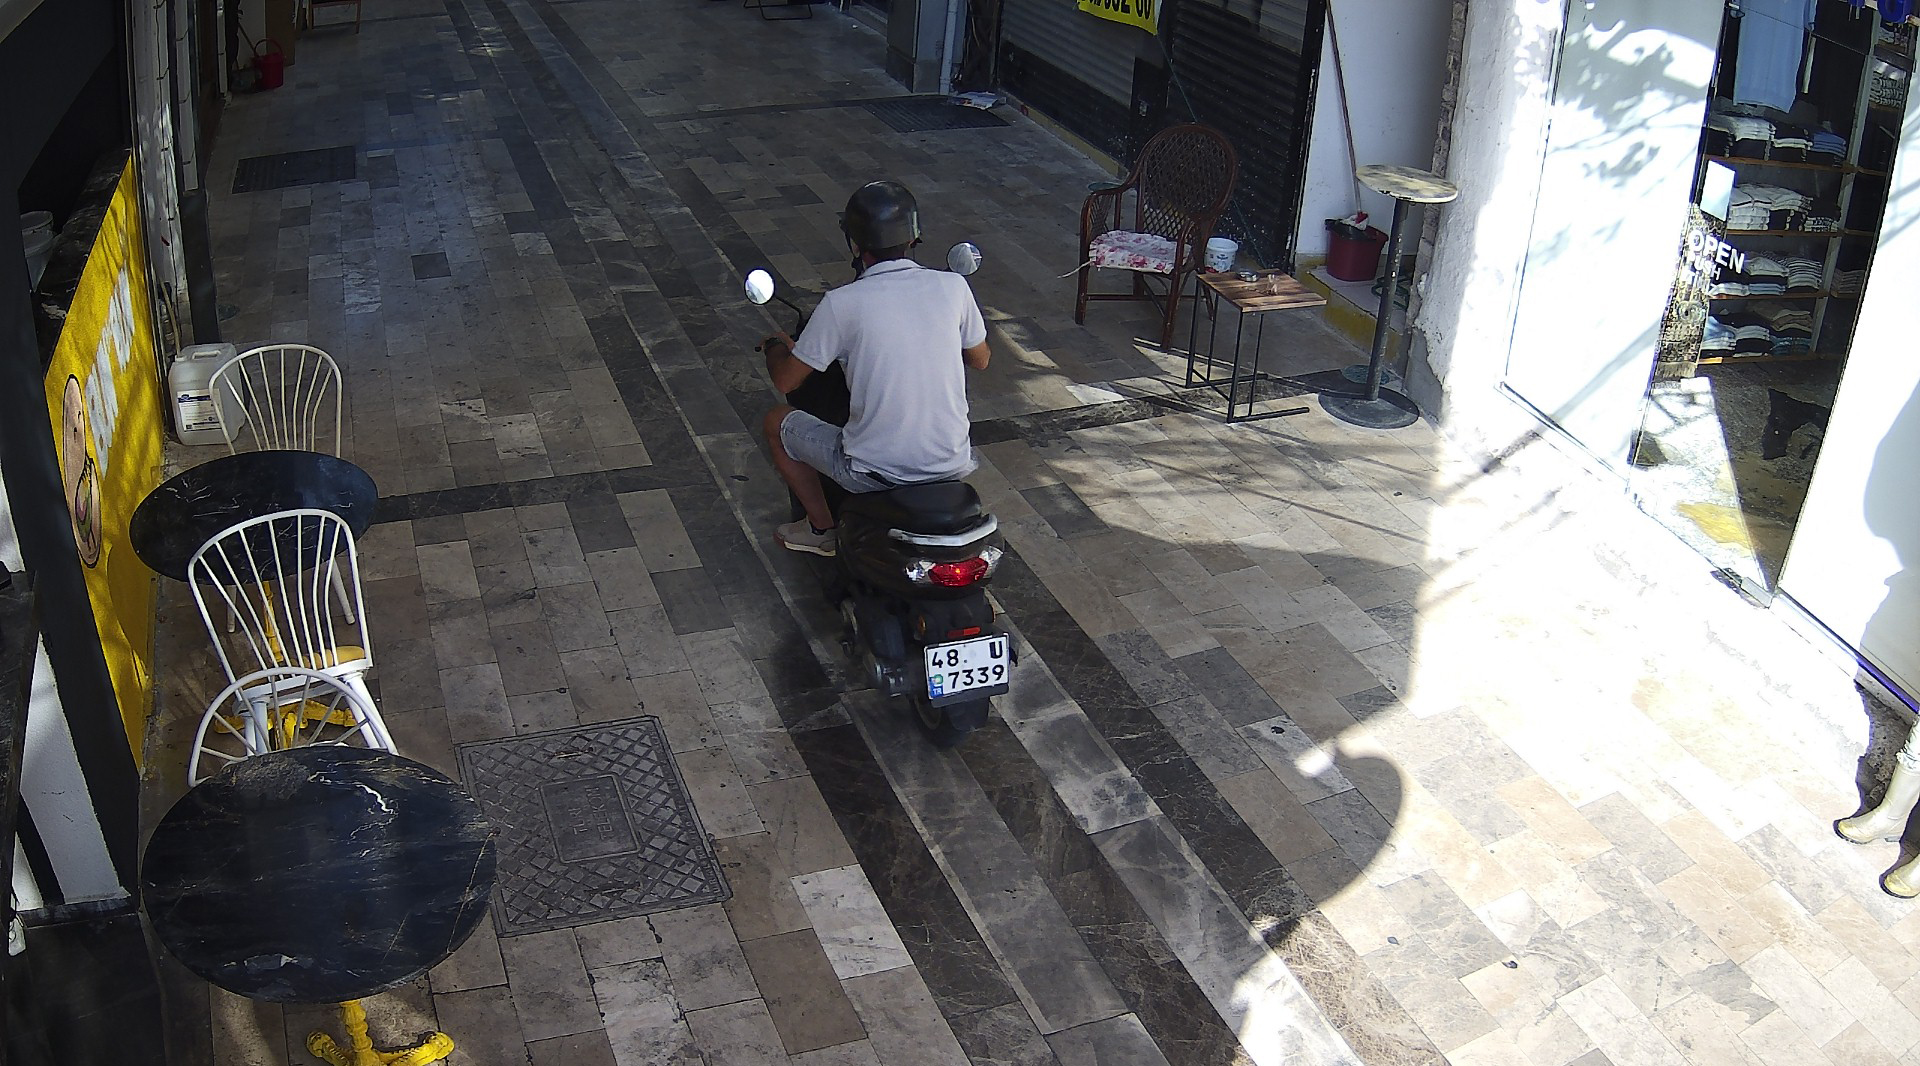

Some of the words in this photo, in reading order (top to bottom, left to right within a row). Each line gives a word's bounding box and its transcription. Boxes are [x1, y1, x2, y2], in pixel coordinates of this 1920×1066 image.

[1686, 250, 1721, 281] PUSH
[1688, 229, 1745, 274] OPEN
[931, 648, 960, 669] 48
[988, 640, 1004, 660] U
[932, 687, 943, 696] TR
[947, 664, 1005, 690] 7339
